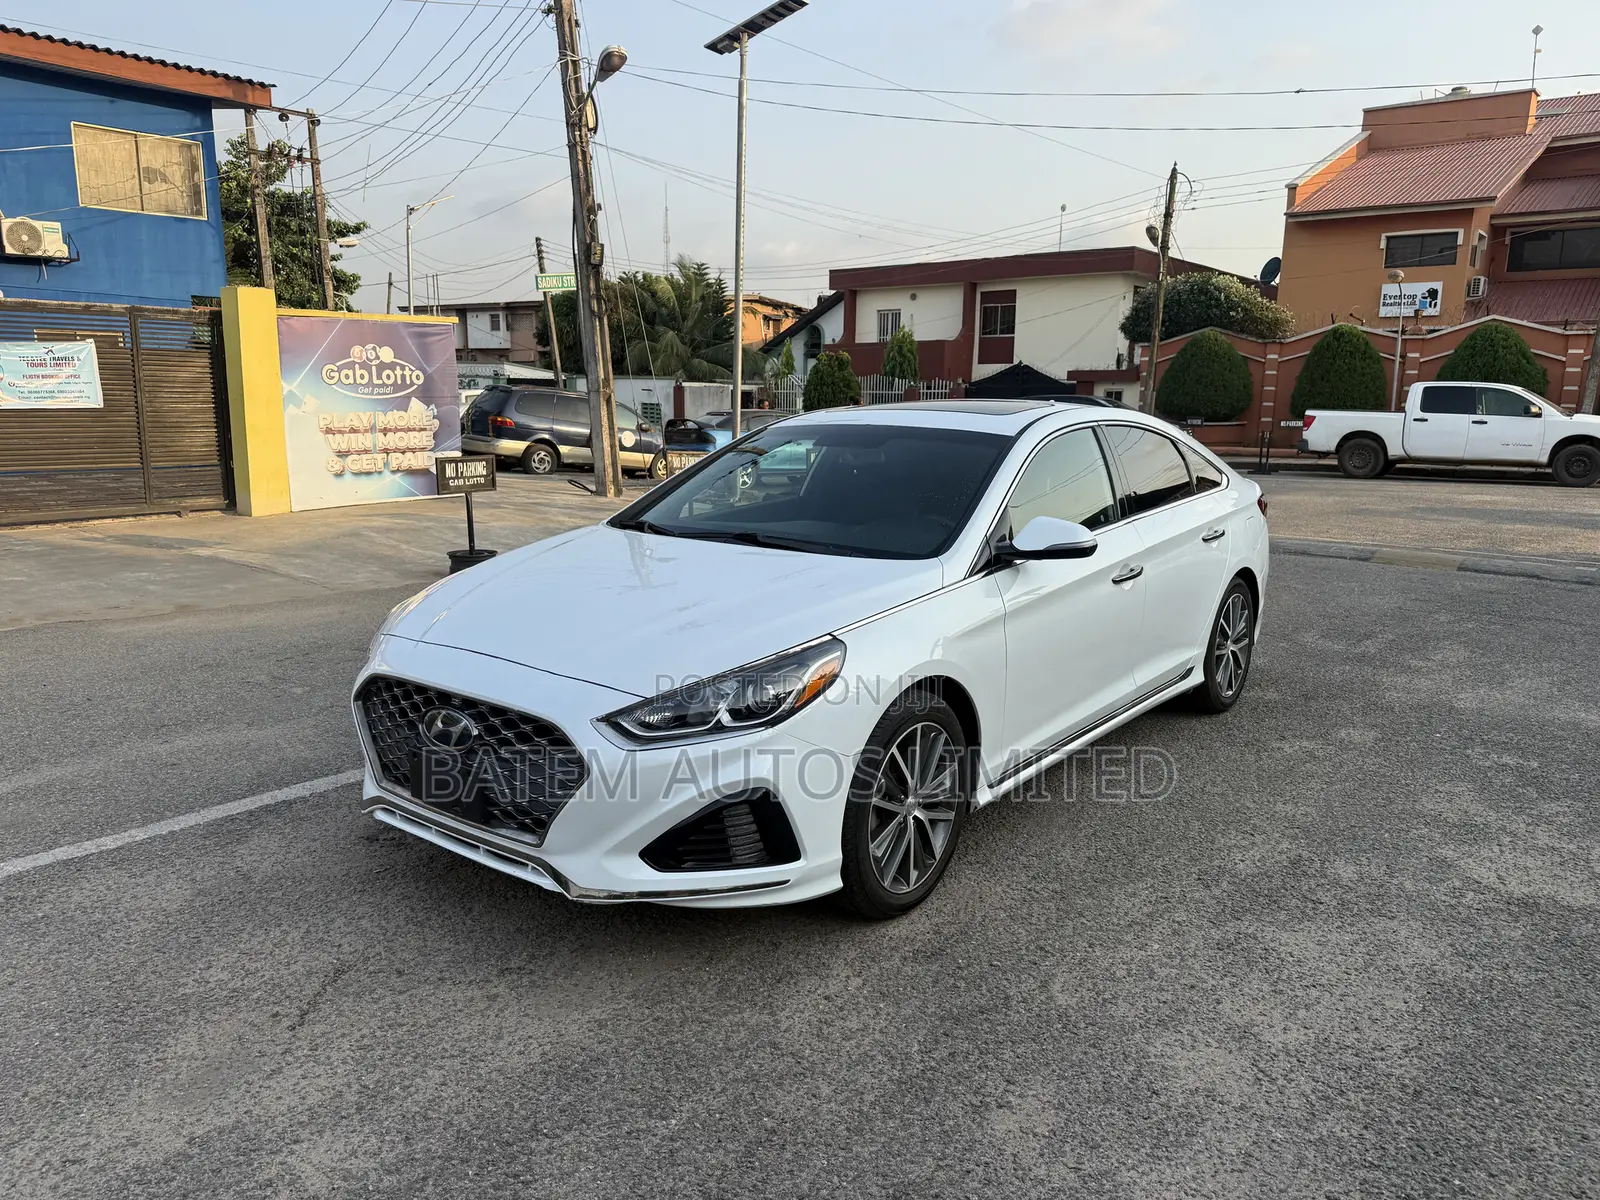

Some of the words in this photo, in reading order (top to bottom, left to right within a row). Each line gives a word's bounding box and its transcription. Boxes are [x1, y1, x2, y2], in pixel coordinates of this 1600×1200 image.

[538, 276, 562, 288] SADIKU
[357, 386, 373, 394] Get
[373, 386, 394, 395] paid!
[318, 412, 374, 432] PLAY
[326, 432, 373, 452] WIN
[377, 431, 434, 451] MORE
[346, 453, 387, 472] GET
[388, 452, 436, 471] PAID
[445, 463, 456, 478] NO
[457, 461, 487, 477] PARKING
[465, 477, 485, 485] LOTTO
